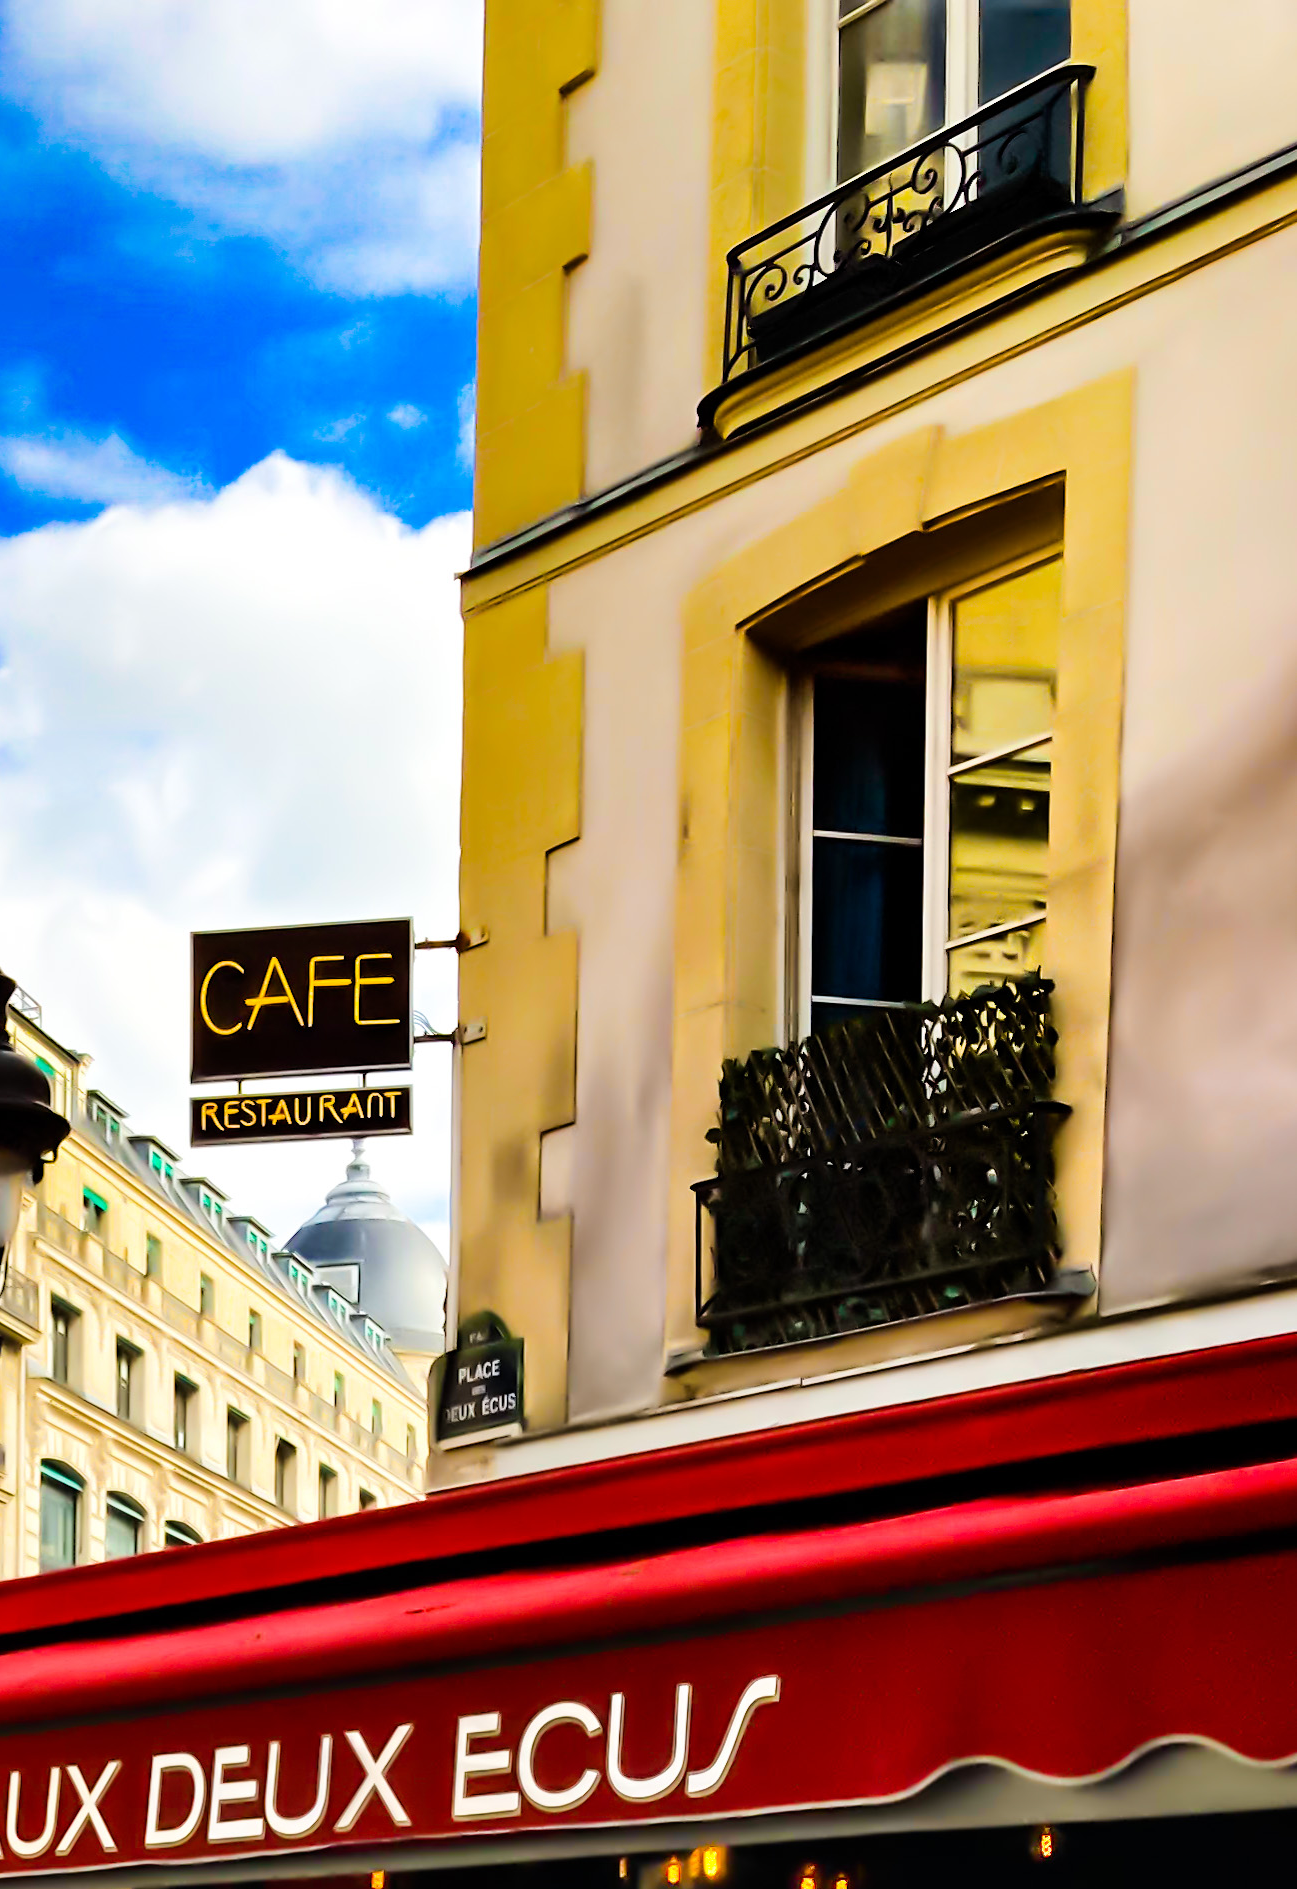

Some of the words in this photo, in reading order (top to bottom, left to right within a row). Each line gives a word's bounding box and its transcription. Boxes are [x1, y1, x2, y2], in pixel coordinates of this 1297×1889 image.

[200, 952, 401, 1036] CAFE
[200, 1090, 403, 1132] RESTAURANT
[458, 1359, 501, 1385] PLACE
[481, 1392, 517, 1416] ÉCUS
[144, 1723, 414, 1849] DEUX
[451, 1674, 781, 1821] ECUS
